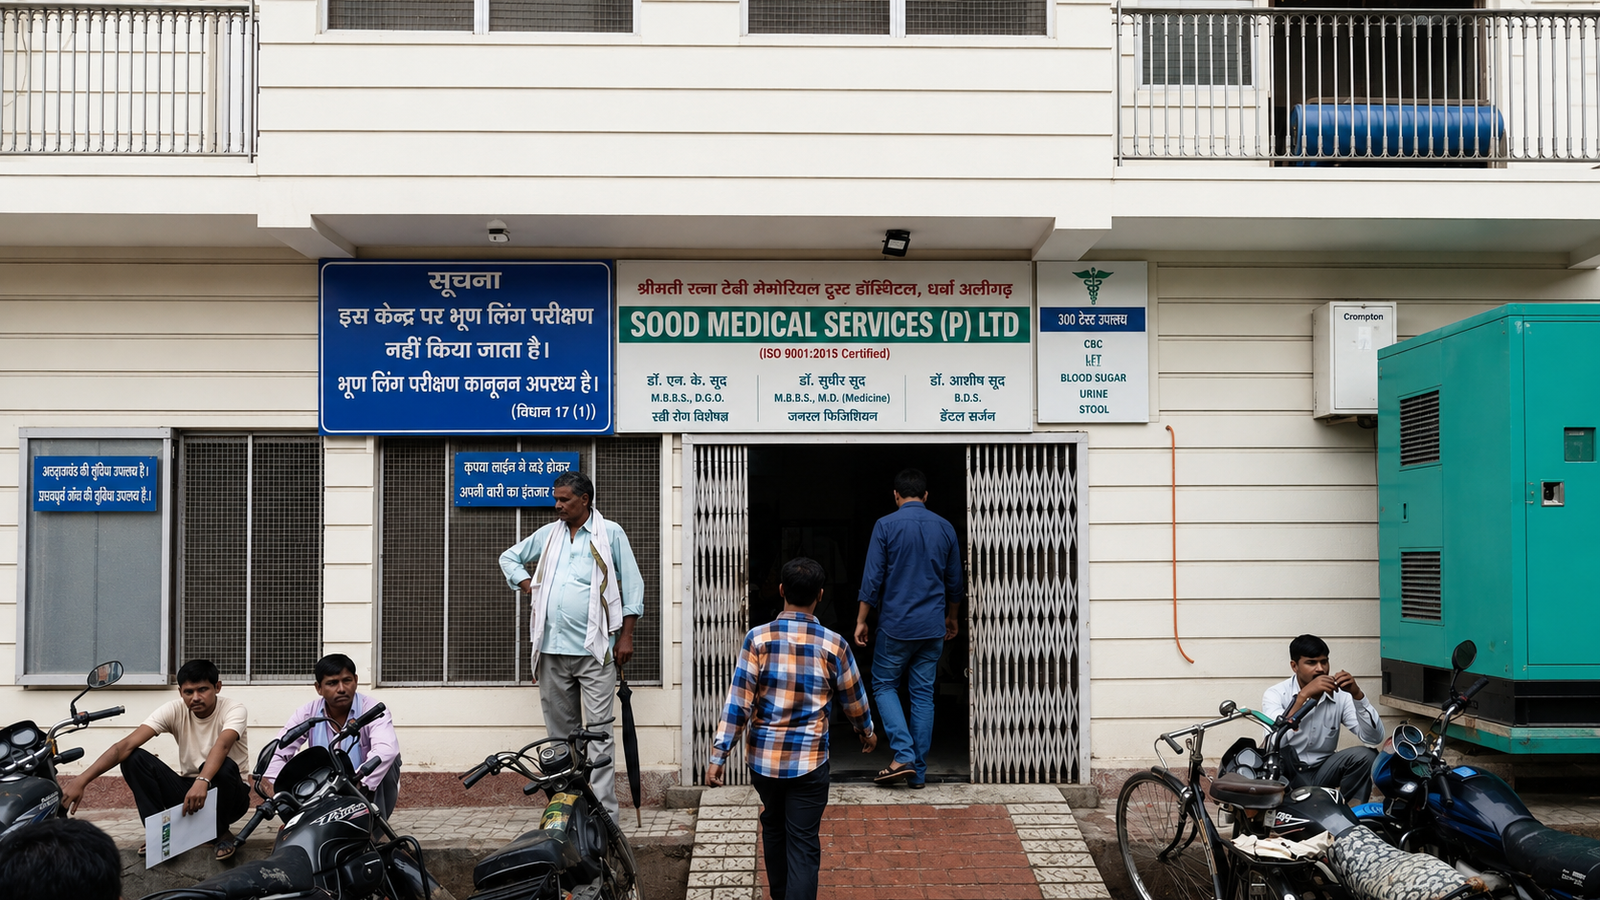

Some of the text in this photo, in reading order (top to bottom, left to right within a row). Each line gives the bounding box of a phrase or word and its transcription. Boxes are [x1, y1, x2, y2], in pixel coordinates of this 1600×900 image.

[427, 271, 503, 296] सूचना
[636, 278, 684, 296] श्रीमती
[337, 308, 370, 329] इस
[373, 301, 416, 327] केन्द्र
[419, 308, 445, 325] पर
[486, 301, 527, 325] लिंग
[530, 301, 595, 326] परीक्षण
[1057, 313, 1076, 326] 300
[1343, 312, 1384, 322] Crompton
[630, 310, 1019, 342] SOOD MEDICAL SERVICES (P) LTD
[384, 335, 422, 360] नहीं
[425, 335, 473, 359] किया
[476, 342, 523, 359] जाता
[1083, 339, 1103, 349] CBC
[759, 347, 782, 361] (ISO
[841, 346, 891, 361] Certified)
[1060, 373, 1127, 383] BLOOD SUGAR
[370, 370, 405, 393] लिंग
[408, 370, 461, 393] परीक्षण
[463, 376, 522, 399] कानूनन
[651, 393, 725, 404] M.B.B.S., D.G.O.
[774, 393, 891, 404] M.B.B.S., M.D. (Medicine)
[954, 392, 982, 403] B.D.S.
[1079, 389, 1109, 399] URINE
[555, 406, 570, 418] 17
[672, 408, 691, 422] रोग
[1079, 404, 1110, 414] STOOL
[787, 411, 821, 422] जनरल
[506, 486, 520, 498] का
